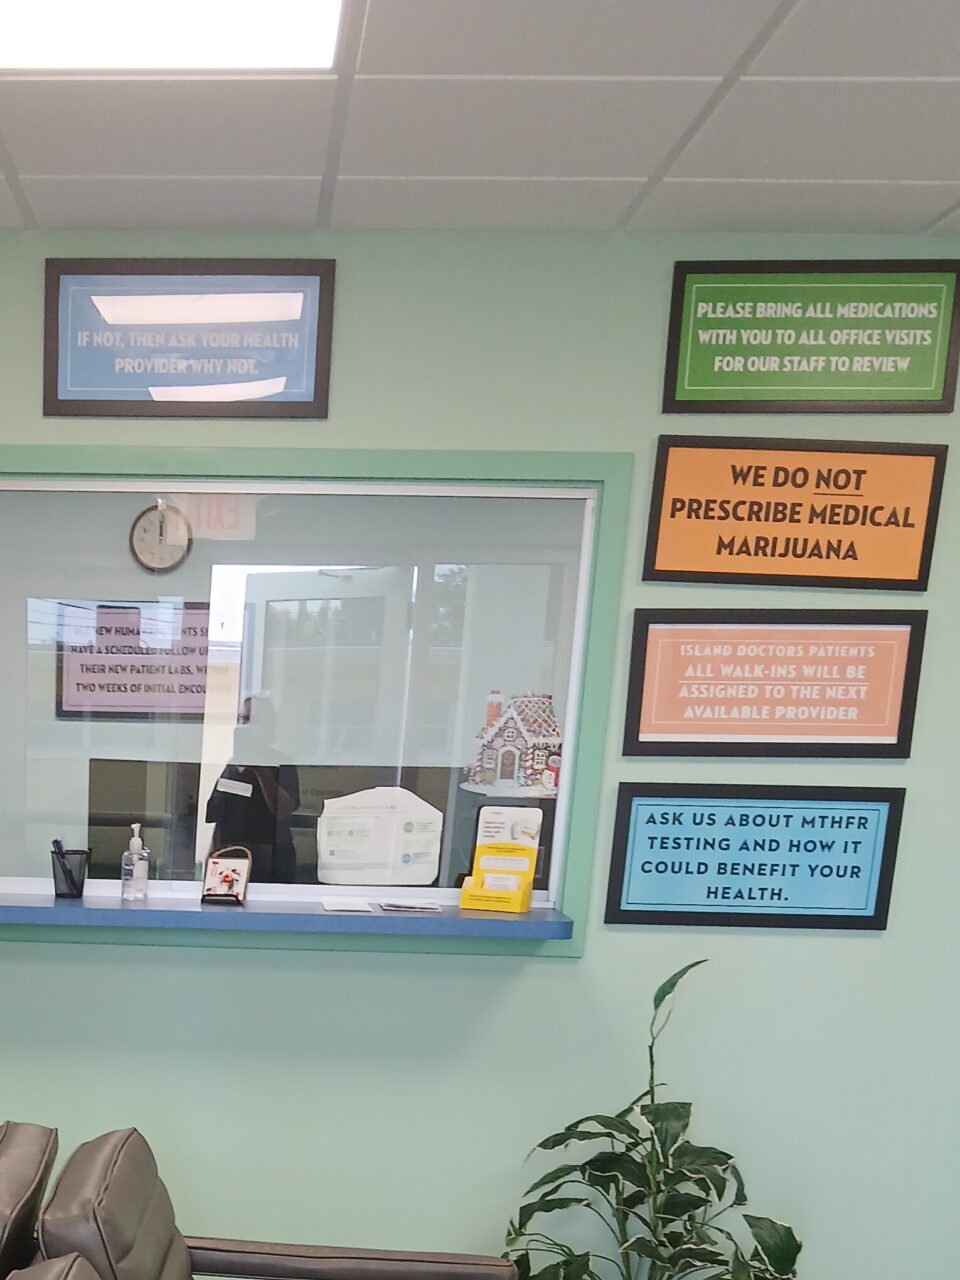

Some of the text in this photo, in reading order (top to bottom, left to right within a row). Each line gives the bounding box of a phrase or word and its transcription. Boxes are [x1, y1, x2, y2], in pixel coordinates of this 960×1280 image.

[696, 302, 938, 318] PLEASE BRING ALL MEDICATIONS
[77, 332, 298, 348] IF NOT, THEN ASK YOUR HEALTH
[698, 330, 932, 345] WITH YOU TO ALL OFFICE VISITS
[115, 358, 259, 374] PROVIDER WHY NOT.
[714, 356, 911, 372] FOR OUR STAFF TO REVIEW
[730, 465, 867, 490] WE DO NOT
[670, 498, 916, 528] PRESCRIBE MEDICAL
[716, 535, 858, 560] MARIJUANA
[71, 646, 94, 655] HAVE
[96, 646, 103, 655] A
[104, 646, 158, 655] SCHEDULED
[680, 645, 875, 657] ISLAND DOCTORS PATIENTS
[80, 664, 106, 674] THEIR
[108, 664, 128, 674] NEW
[130, 664, 166, 674] PATIENT
[168, 664, 193, 674] LABS,
[684, 664, 866, 678] ALL WALK-INS WILL BE
[76, 683, 96, 693] TWO
[98, 683, 128, 693] WEEKS
[130, 683, 142, 693] OF
[678, 685, 868, 699] ASSIGNED TO THE NEXT
[684, 706, 858, 720] AVAILABLE PROVIDER
[646, 812, 869, 830] ASK US ABOUT MTHFR
[647, 836, 862, 854] TESTING AND HOW IT
[640, 860, 862, 878] COULD BENEFIT YOUR
[706, 886, 789, 901] HEALTH.
